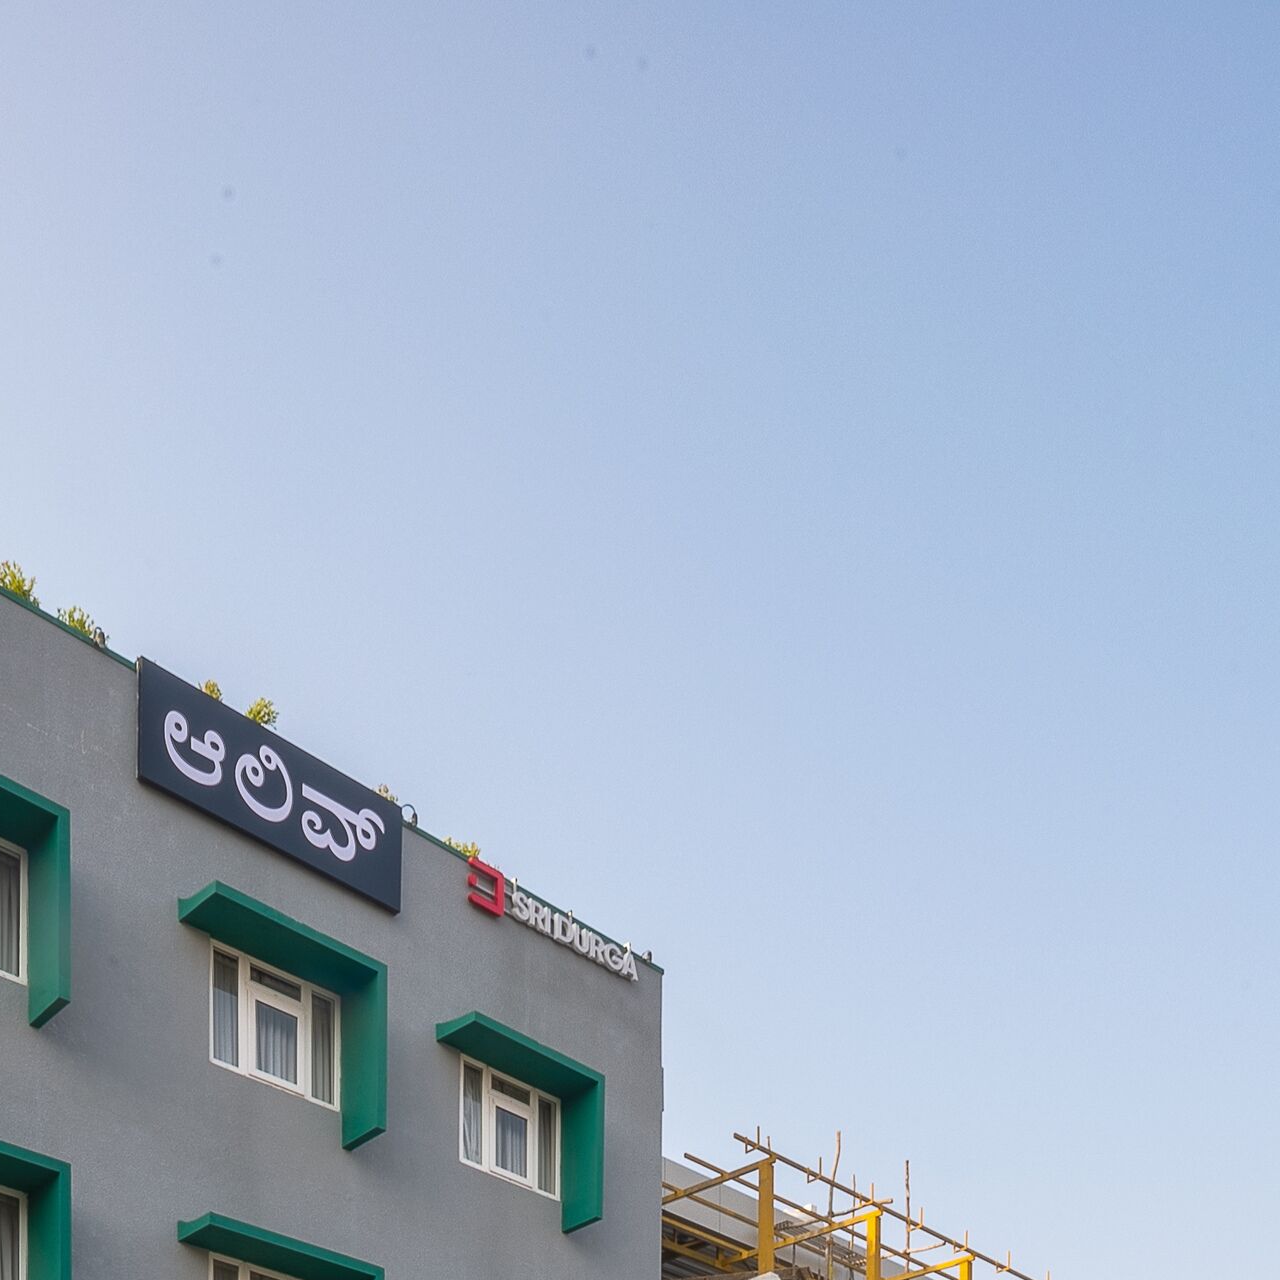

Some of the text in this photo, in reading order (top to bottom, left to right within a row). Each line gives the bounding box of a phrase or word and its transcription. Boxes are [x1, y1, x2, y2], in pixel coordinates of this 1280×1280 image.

[164, 710, 385, 862] ಆಲಿವ್
[511, 891, 639, 982] SRI DURGA
